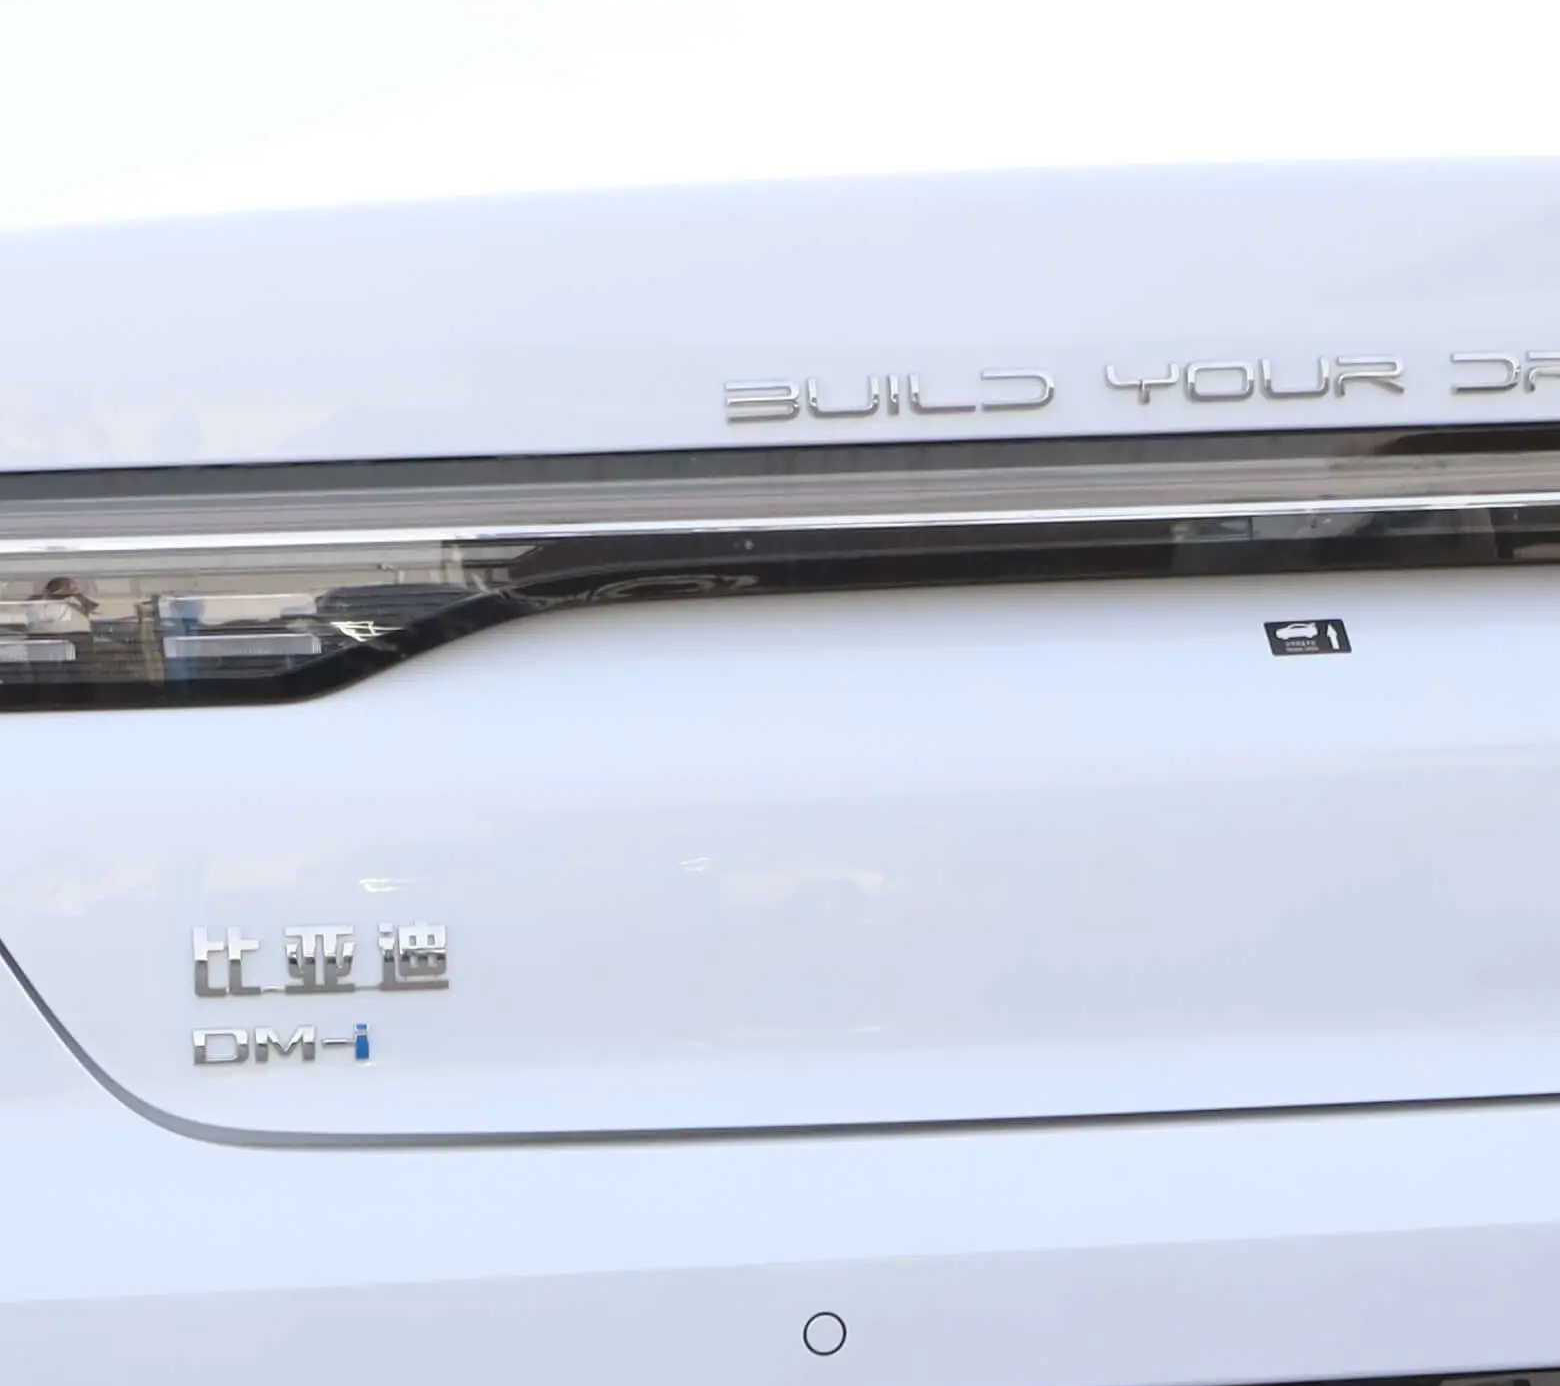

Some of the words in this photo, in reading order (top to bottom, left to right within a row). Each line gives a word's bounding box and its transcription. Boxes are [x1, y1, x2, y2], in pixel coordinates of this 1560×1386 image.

[723, 366, 1056, 423] BUILD
[1105, 352, 1408, 405] YOUR
[191, 919, 450, 998] 比亚迪
[191, 1021, 371, 1066] DM-i
